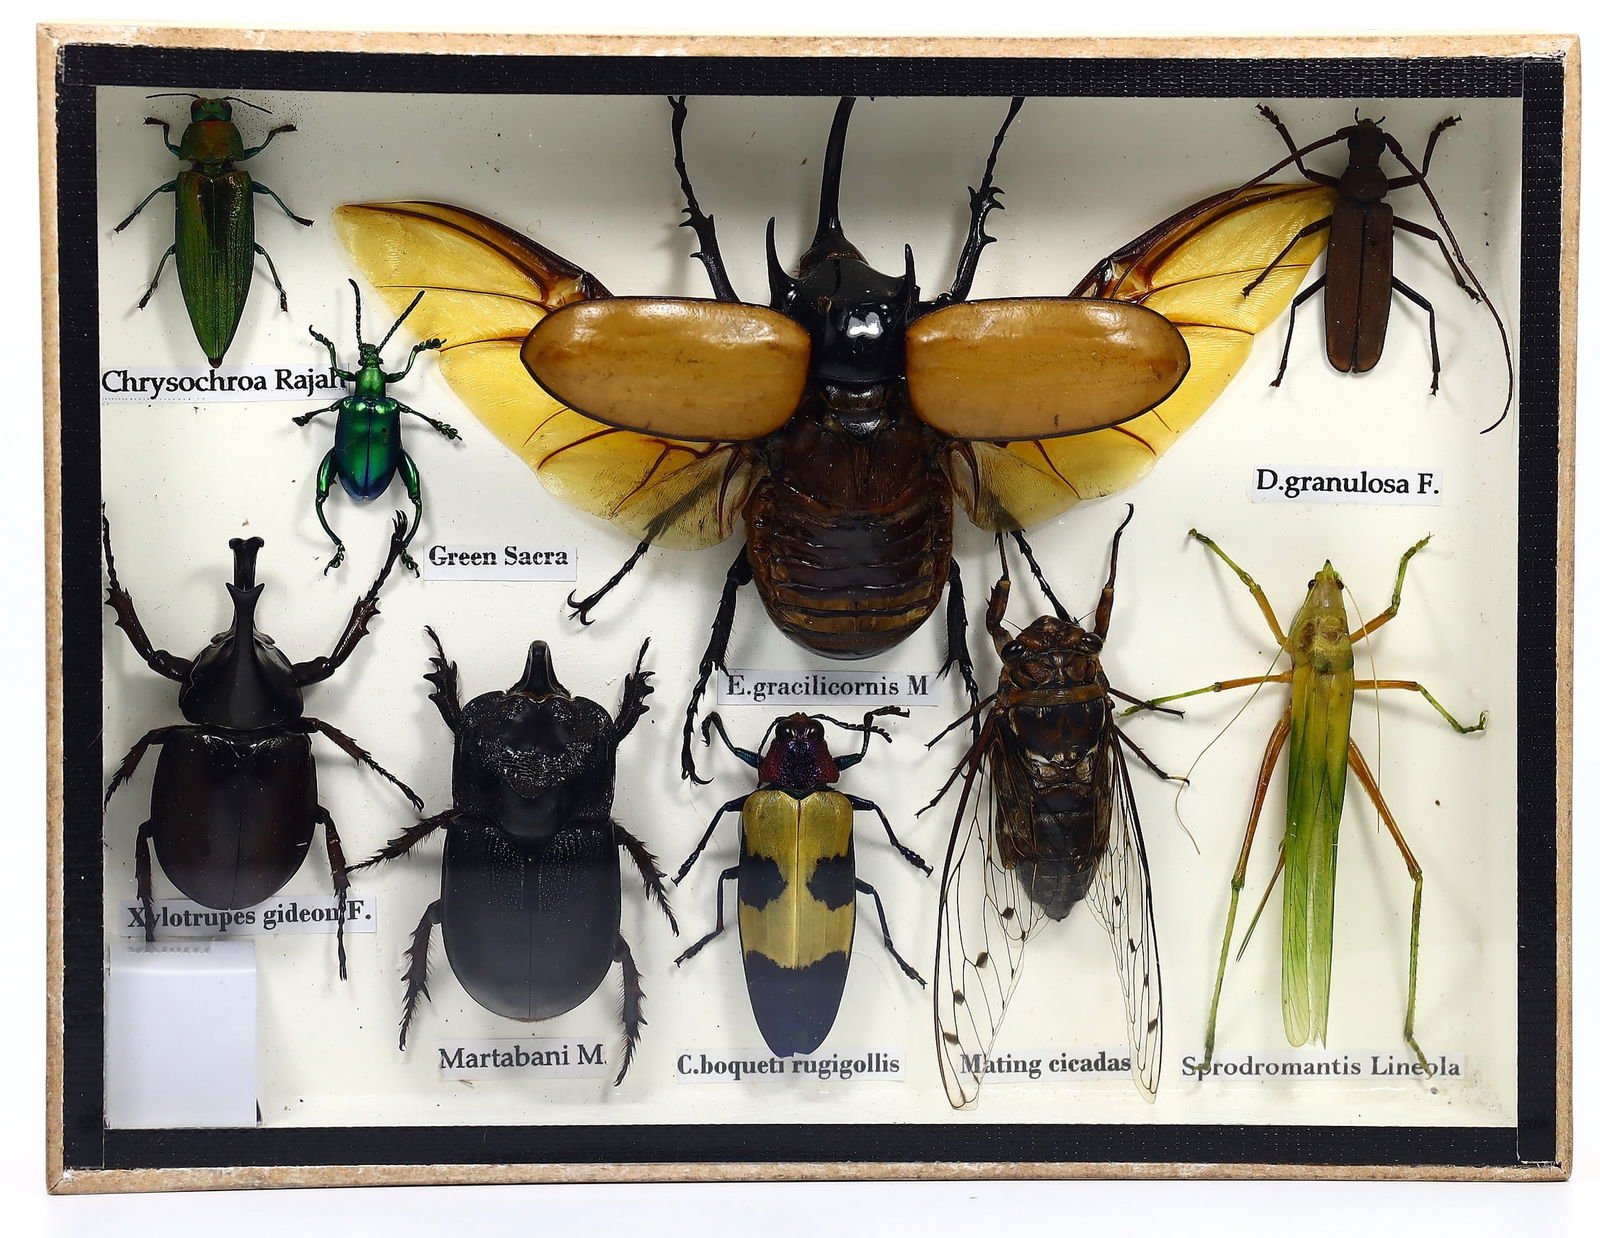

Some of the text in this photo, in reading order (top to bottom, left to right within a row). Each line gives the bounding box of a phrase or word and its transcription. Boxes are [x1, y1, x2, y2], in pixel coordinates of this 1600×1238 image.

[102, 369, 267, 400] Chrysochroa
[1256, 468, 1439, 498] D.granulosa F.
[428, 545, 568, 566] Green Sacra
[726, 674, 929, 702] E.gracilicornis M
[347, 900, 372, 920] F.
[438, 1043, 607, 1069] Martabani M.
[677, 1053, 900, 1080] C.boqueti rugigollis
[960, 1051, 1131, 1079] Mating cicadas
[1182, 1056, 1361, 1081] Sprodromantis
